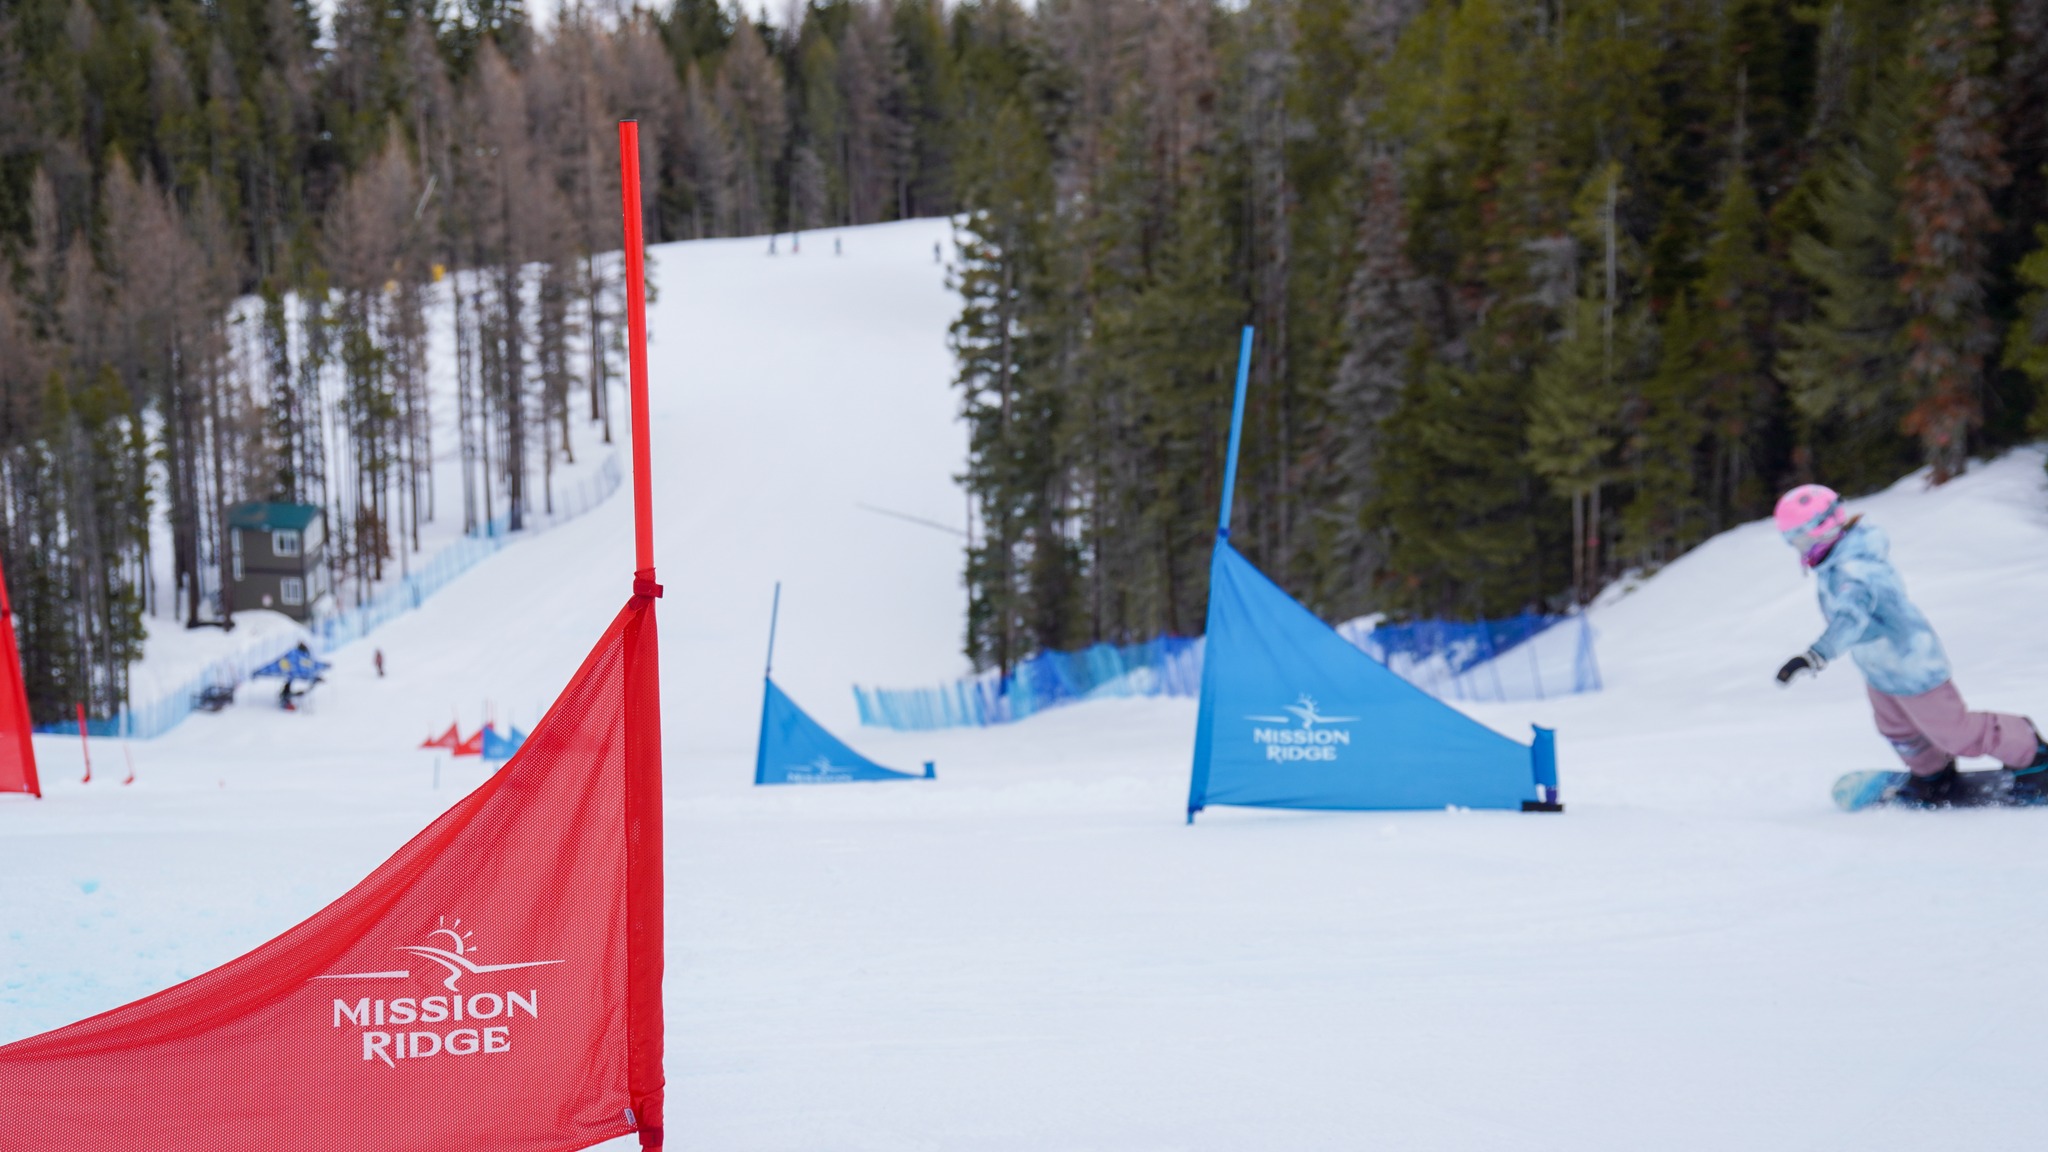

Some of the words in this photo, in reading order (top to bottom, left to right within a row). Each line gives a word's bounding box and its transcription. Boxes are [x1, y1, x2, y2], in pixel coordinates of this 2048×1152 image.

[1253, 727, 1350, 745] MISSION
[1266, 745, 1337, 764] RIDGE
[333, 989, 538, 1028] MISSION
[362, 1026, 511, 1069] RIDGE
